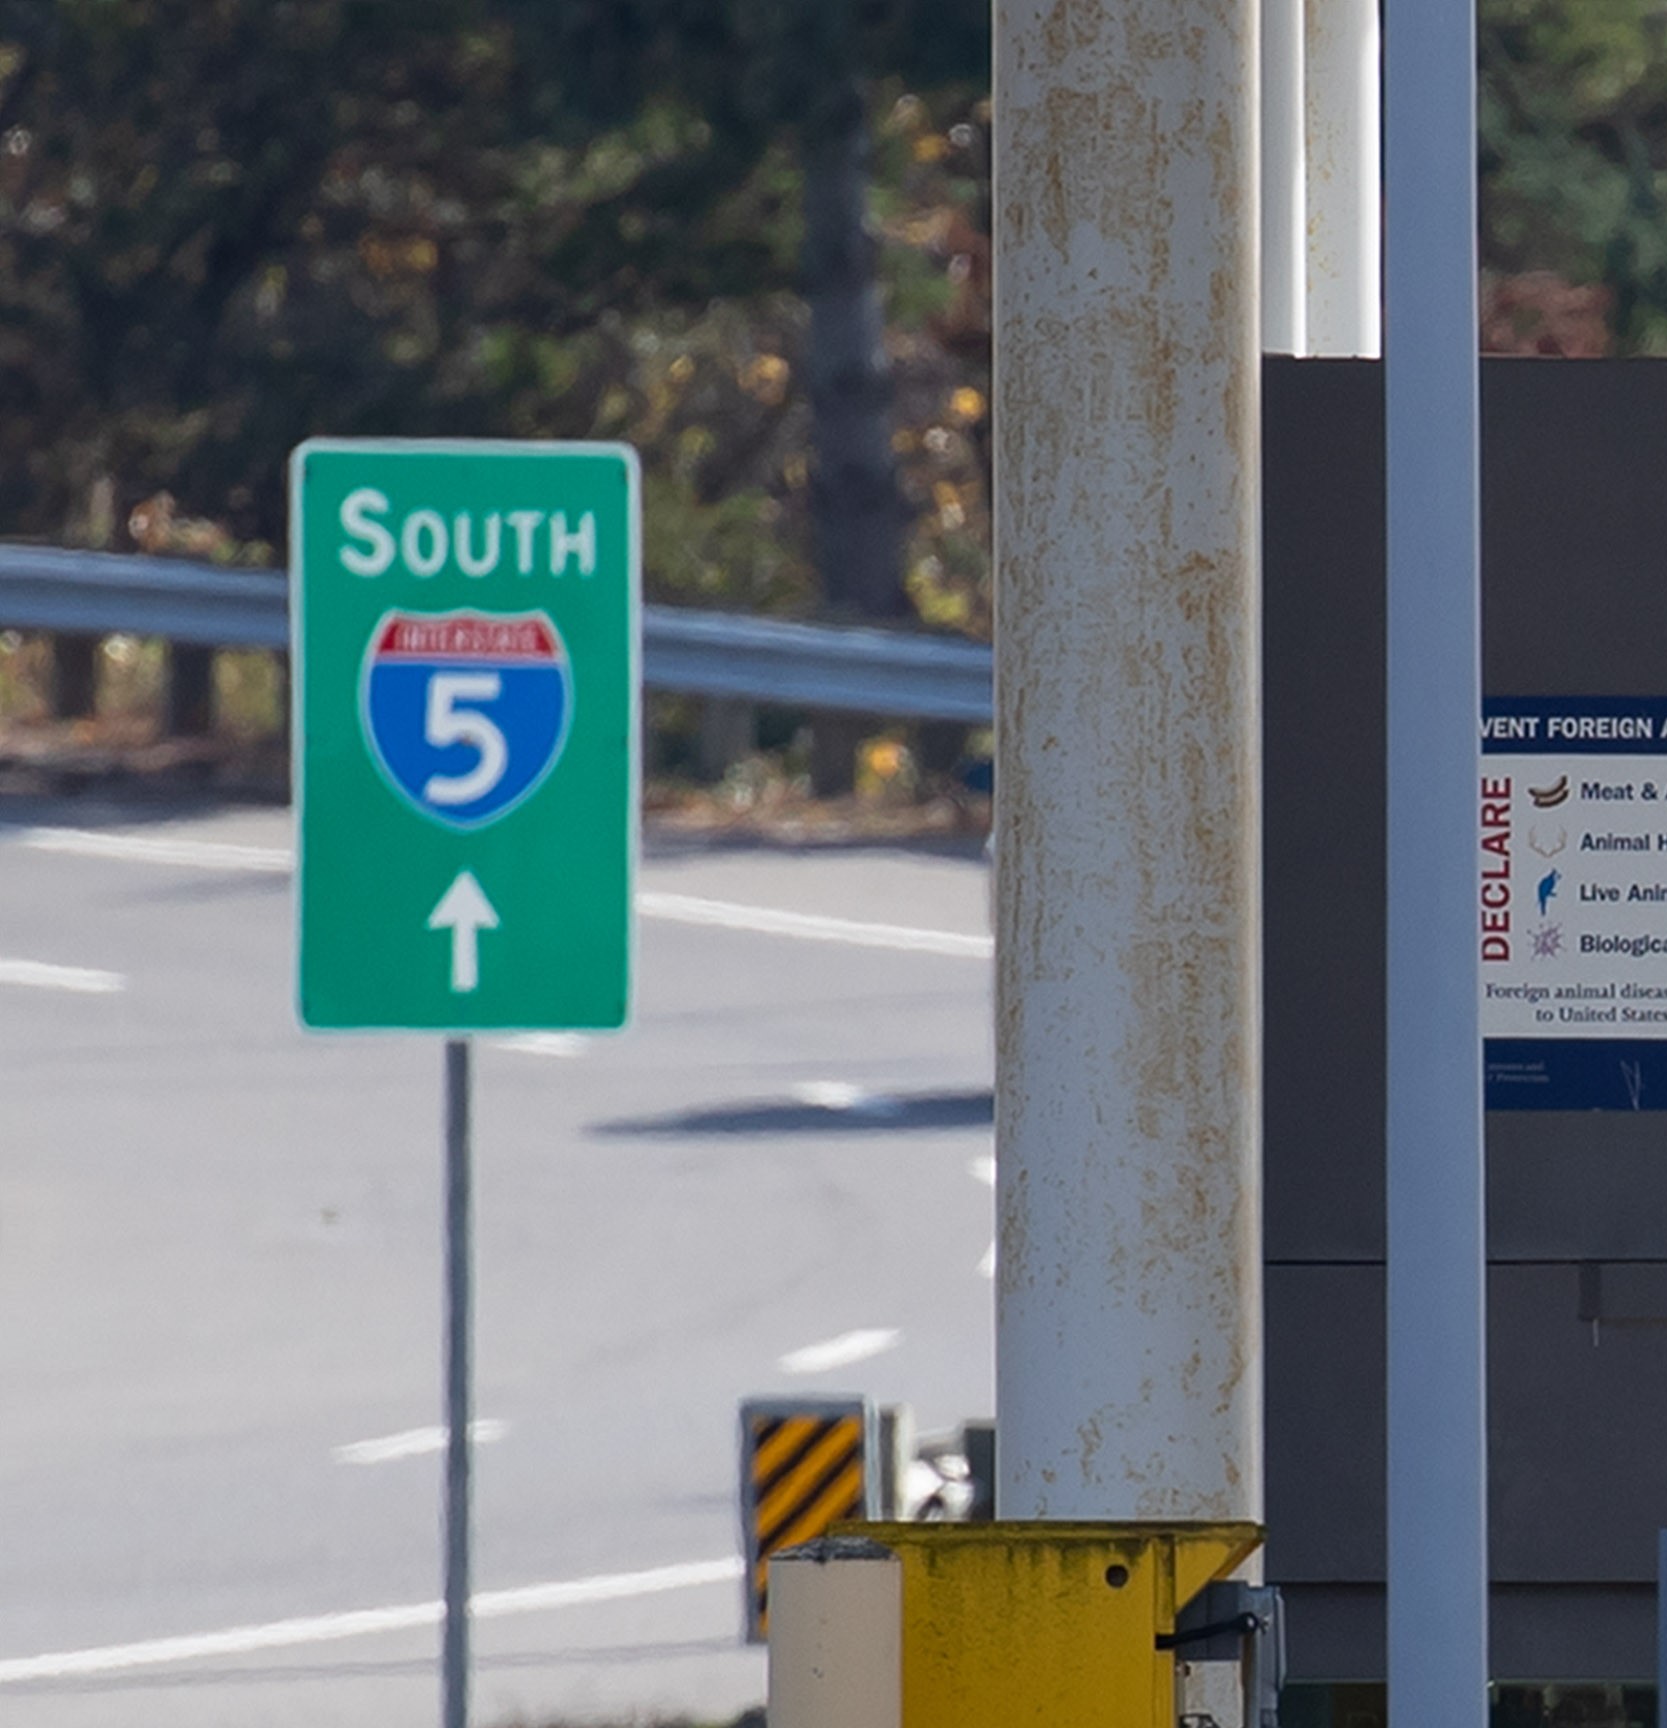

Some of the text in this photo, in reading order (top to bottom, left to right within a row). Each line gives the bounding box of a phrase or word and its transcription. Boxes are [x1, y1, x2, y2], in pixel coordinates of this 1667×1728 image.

[339, 487, 597, 577] SOUTH
[1548, 717, 1652, 739] FOREIGN
[424, 673, 508, 805] 5
[1580, 782, 1634, 801] Meat
[1640, 782, 1658, 801] &
[1580, 832, 1651, 851] Animal
[1481, 777, 1512, 962] DECLARE
[1580, 883, 1620, 902] Live
[1485, 983, 1550, 1004] Foreign
[1554, 983, 1616, 999] animal
[1535, 1008, 1555, 1022] to
[1558, 1006, 1617, 1023] United
